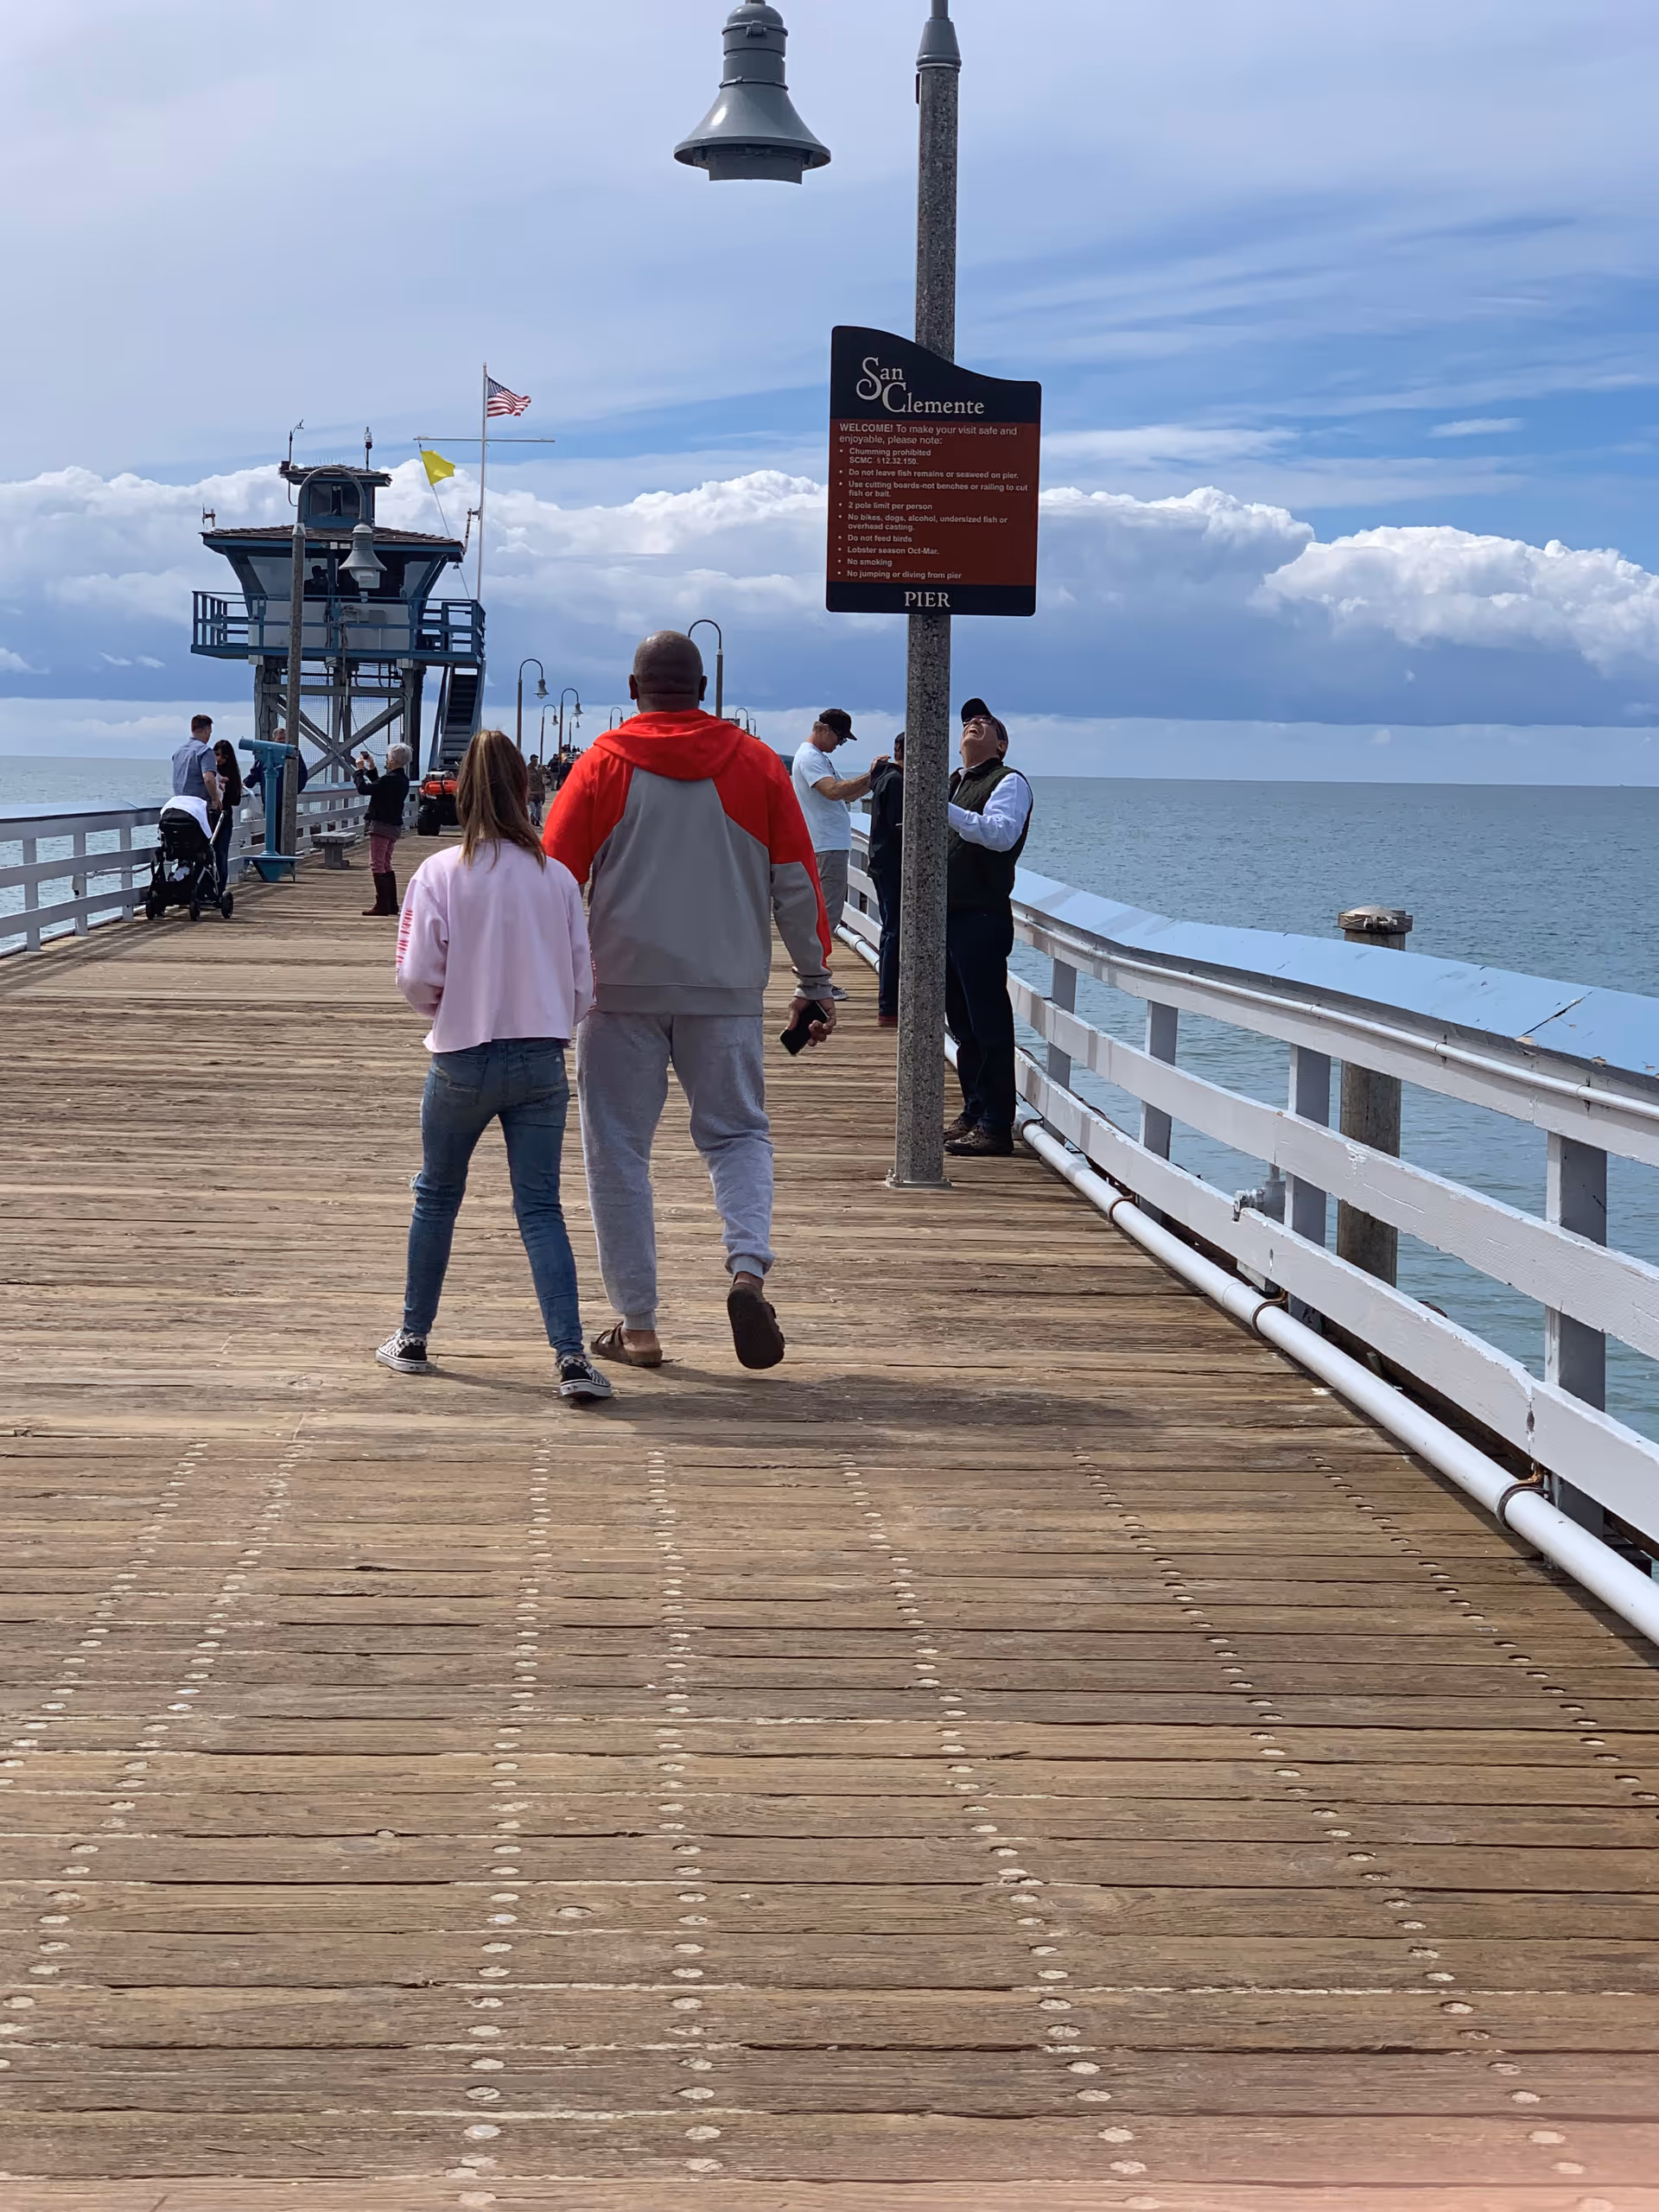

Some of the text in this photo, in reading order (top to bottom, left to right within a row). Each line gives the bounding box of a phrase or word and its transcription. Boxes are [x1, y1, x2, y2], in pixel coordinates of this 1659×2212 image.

[856, 357, 903, 400] San
[882, 382, 984, 414] Clemente
[840, 423, 1017, 435] WELCOME! To make your visit safe and
[840, 435, 885, 444] enjoyable,
[888, 436, 917, 445] please
[893, 448, 931, 457] prohibited
[981, 483, 1004, 492] railing
[859, 570, 890, 579] jumping
[902, 571, 925, 580] diving
[905, 592, 950, 607] PIER
